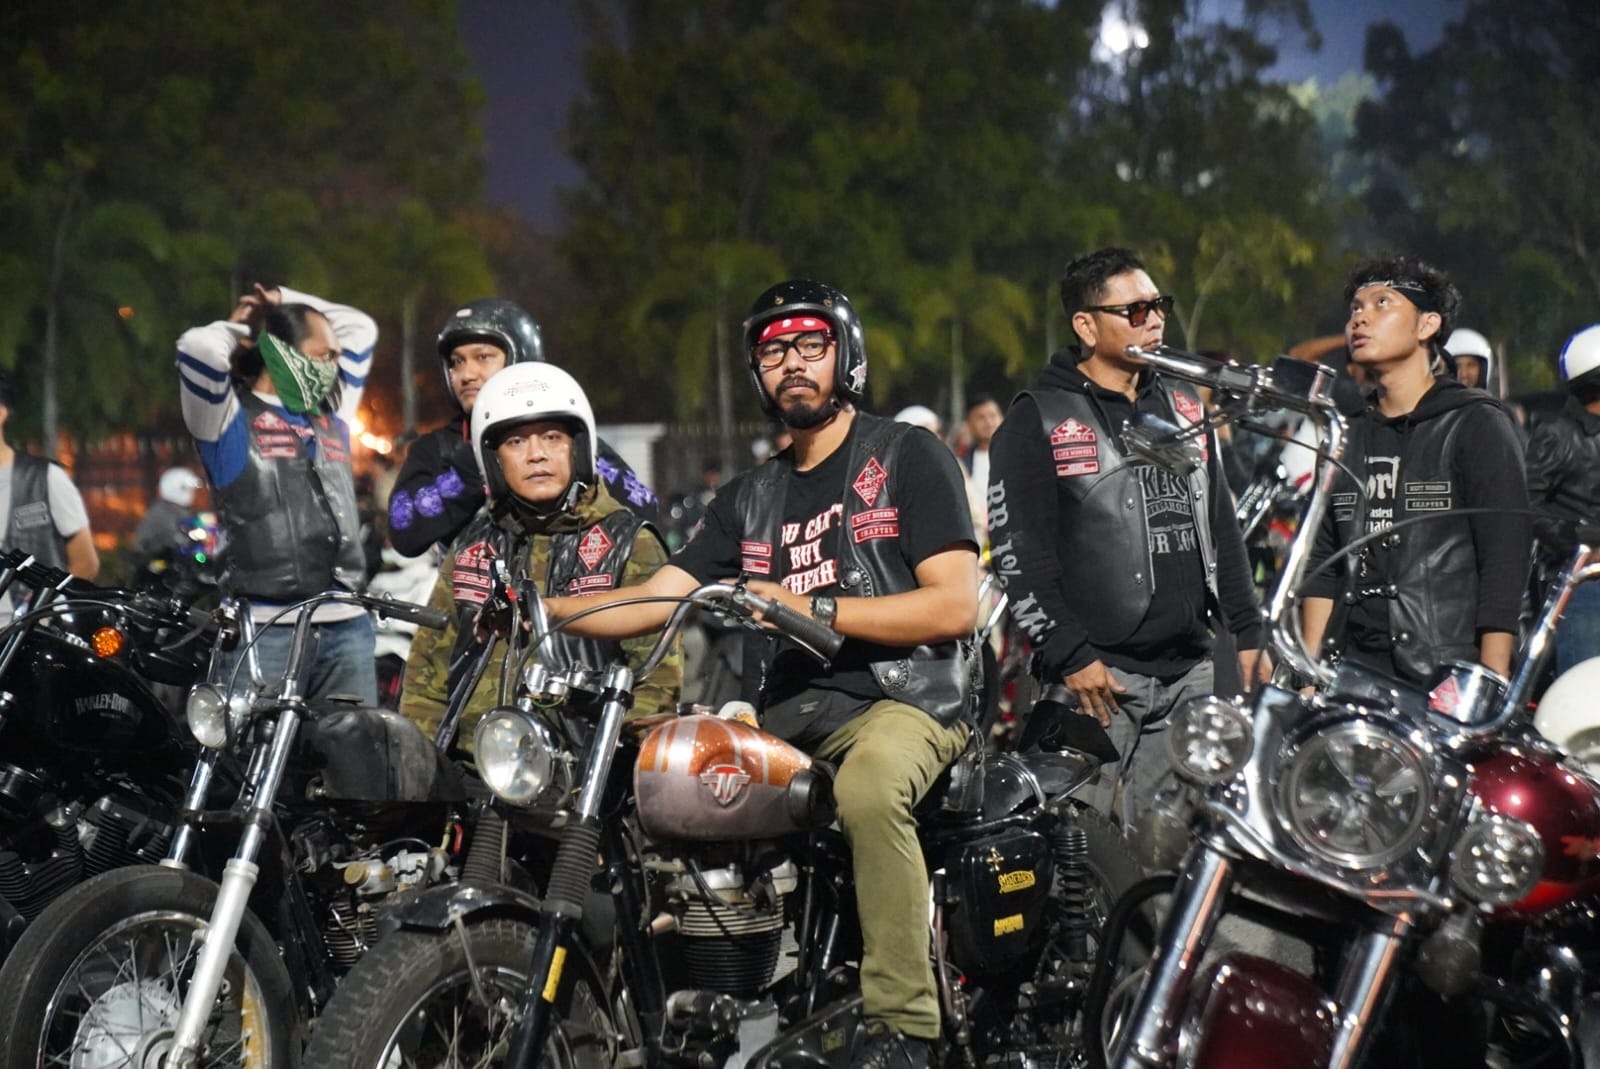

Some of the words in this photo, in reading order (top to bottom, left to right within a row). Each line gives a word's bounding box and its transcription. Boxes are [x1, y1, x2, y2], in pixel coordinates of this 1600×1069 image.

[1369, 507, 1393, 518] astest
[860, 526, 894, 538] CHAPTER
[789, 539, 822, 570] BUY
